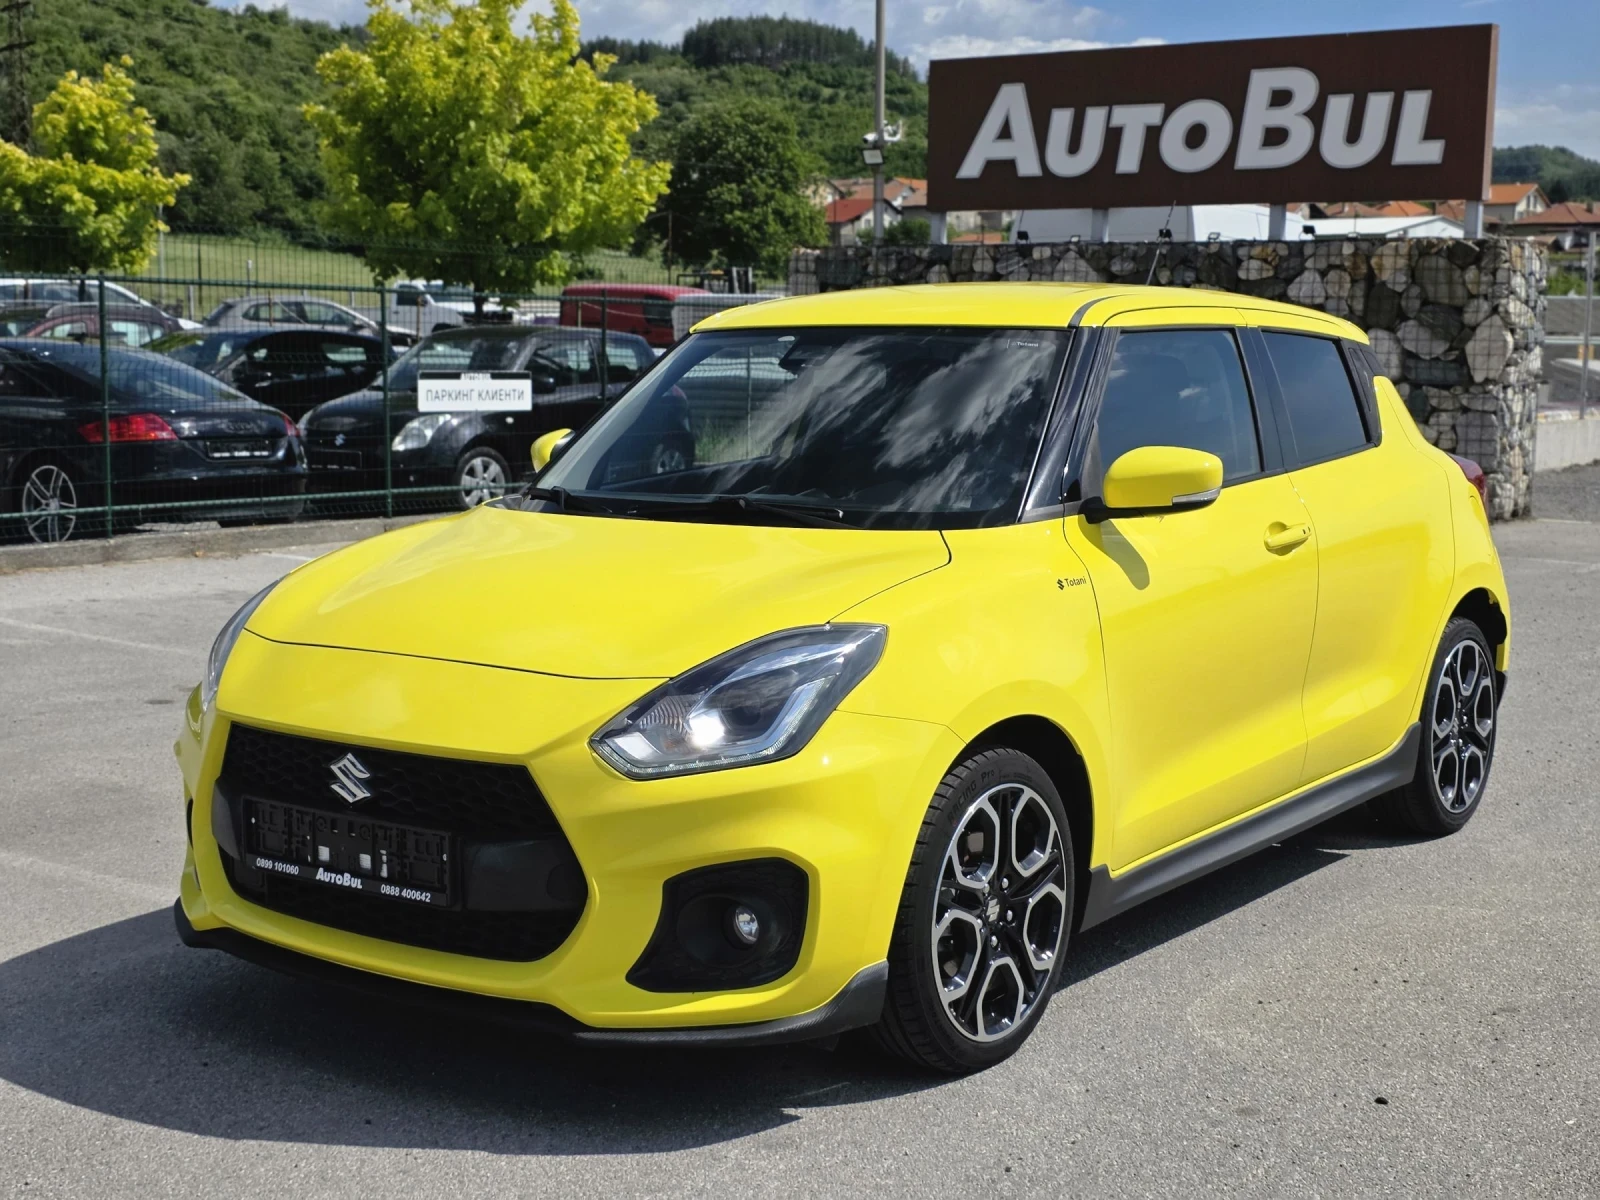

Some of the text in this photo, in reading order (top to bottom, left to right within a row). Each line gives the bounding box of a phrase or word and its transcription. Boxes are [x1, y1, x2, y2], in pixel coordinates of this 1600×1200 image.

[426, 388, 525, 402] ПАРКИНГ КЛИЕНТИ
[1064, 576, 1087, 587] Totani
[256, 857, 299, 875] 0899 101060
[380, 884, 431, 903] 0888 400642
